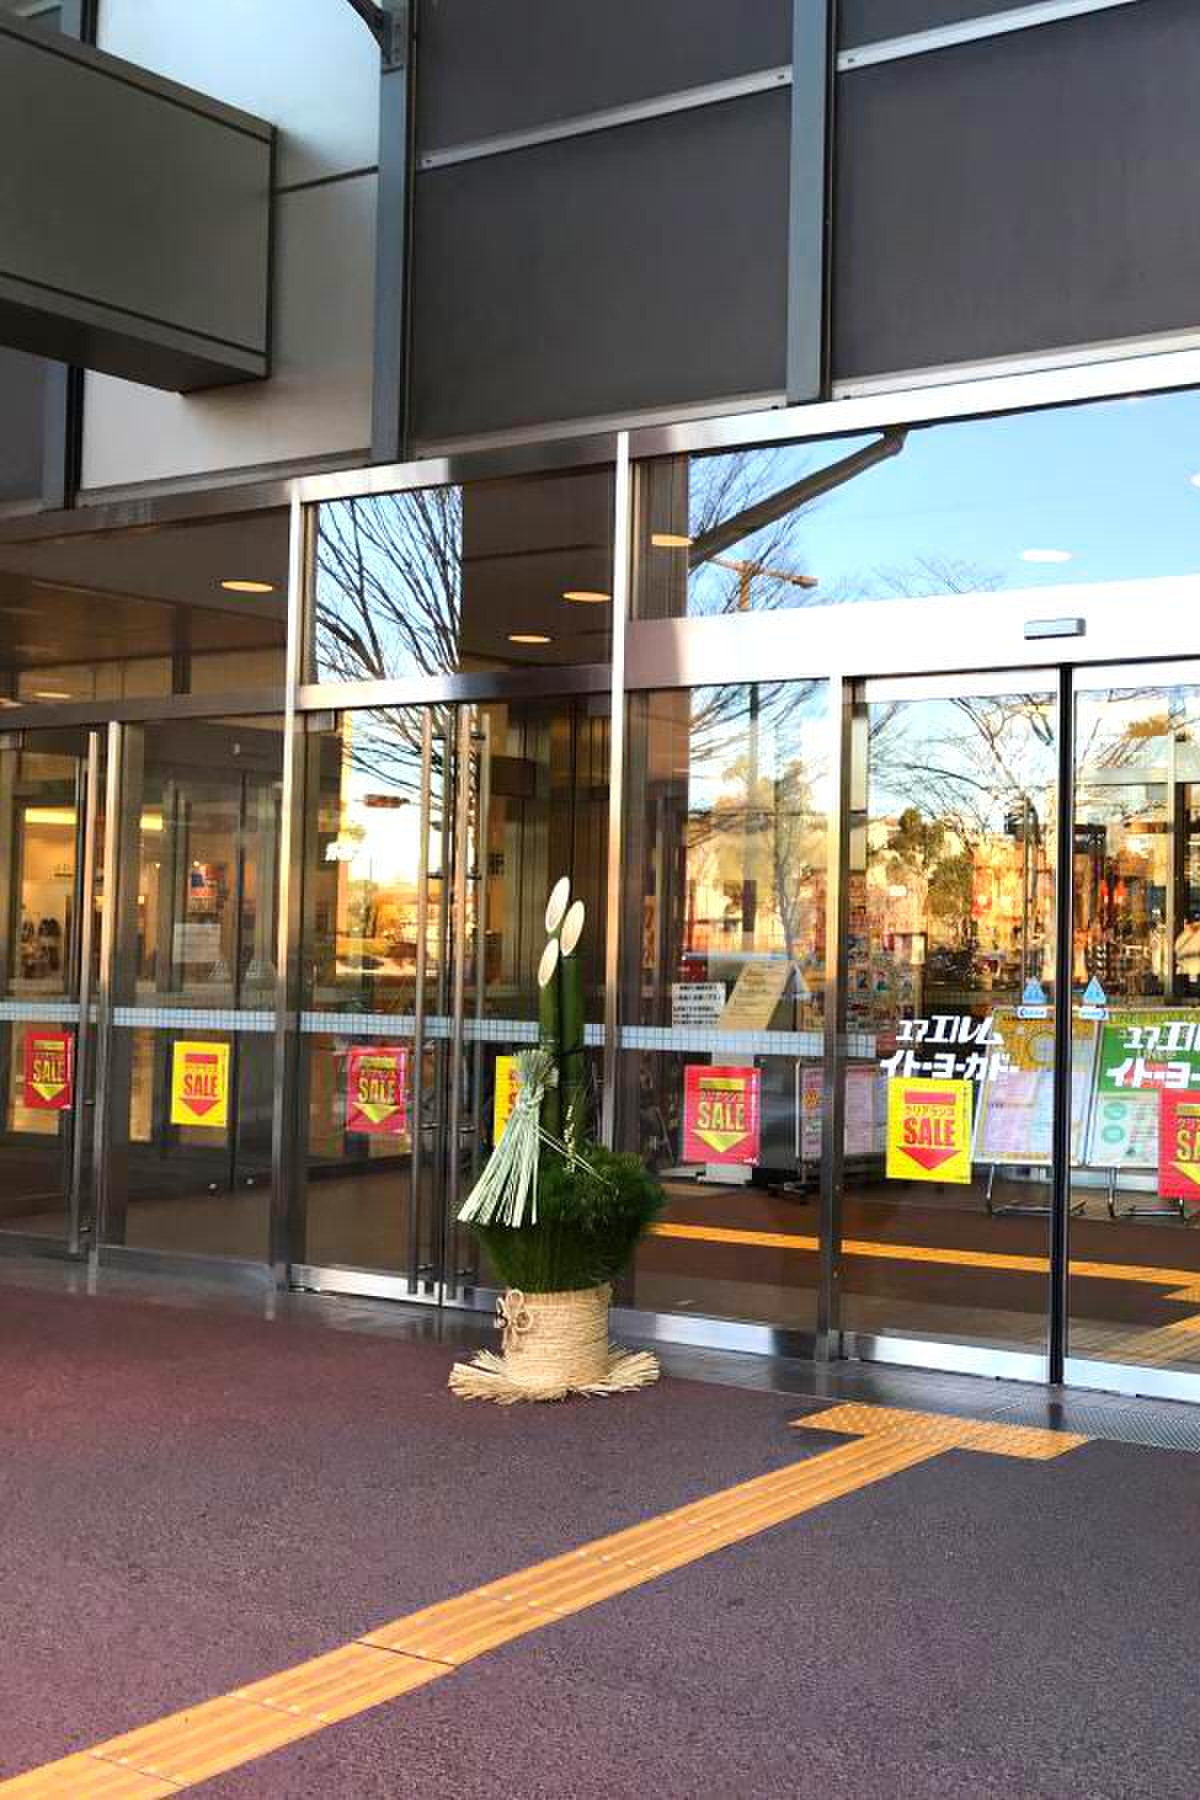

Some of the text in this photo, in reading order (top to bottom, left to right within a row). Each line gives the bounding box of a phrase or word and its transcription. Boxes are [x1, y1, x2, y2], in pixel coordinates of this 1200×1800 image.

[33, 1059, 65, 1082] SALE
[184, 1074, 218, 1097] SALE
[358, 1077, 396, 1104] SALE
[698, 1102, 745, 1130] SALE
[903, 1117, 955, 1147] SALE
